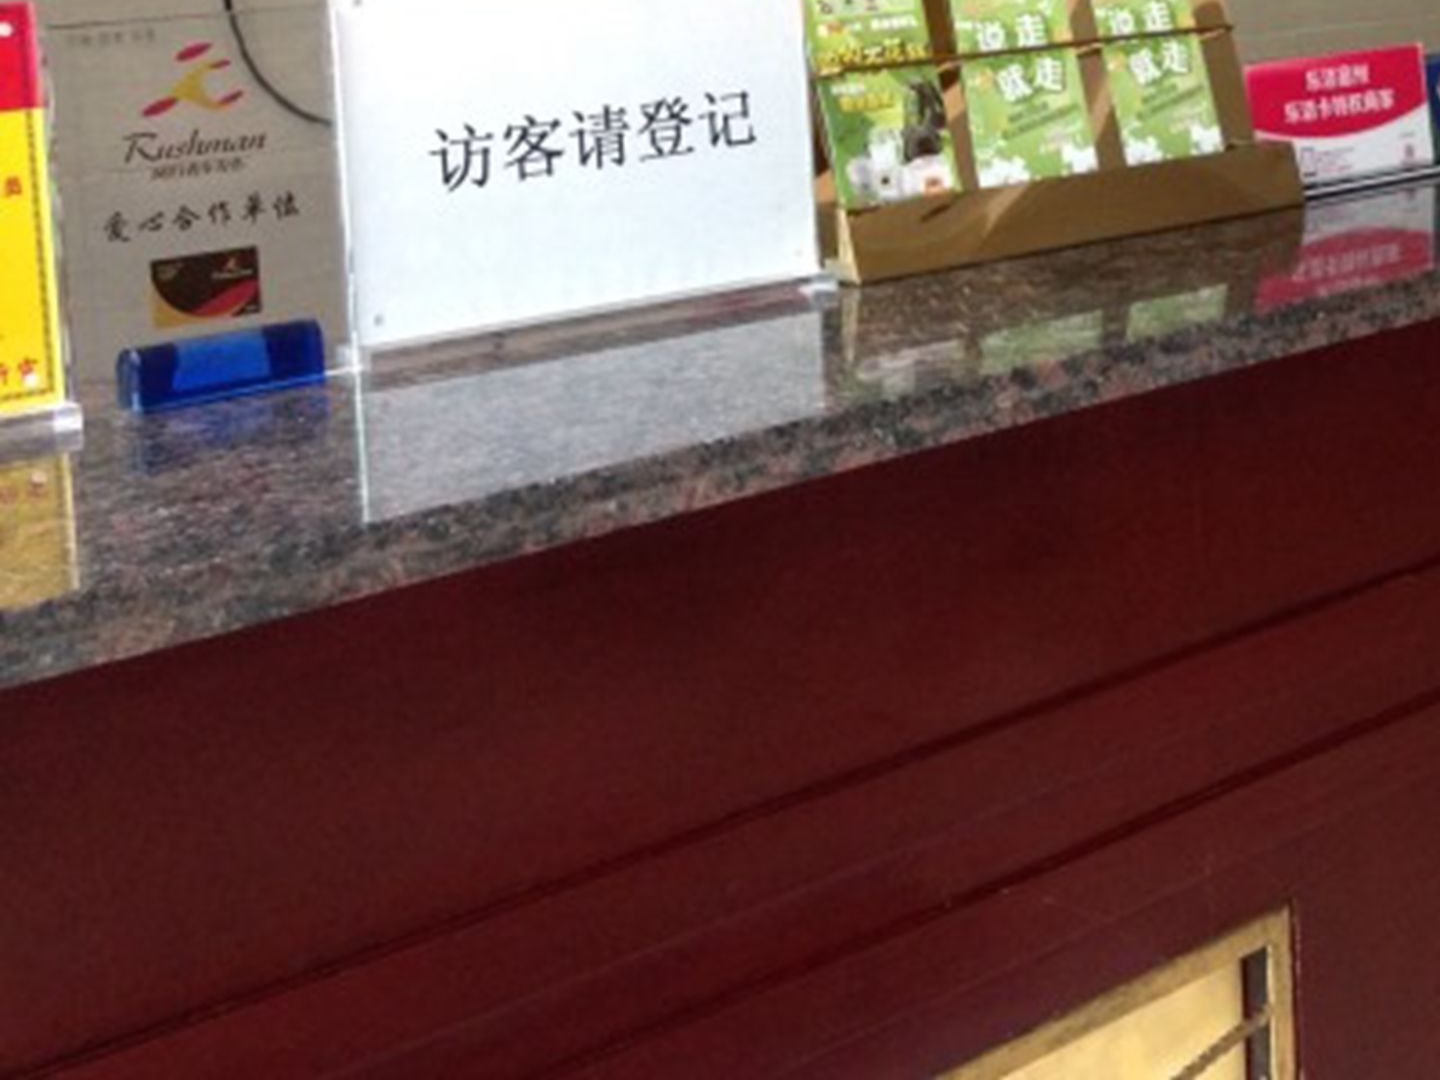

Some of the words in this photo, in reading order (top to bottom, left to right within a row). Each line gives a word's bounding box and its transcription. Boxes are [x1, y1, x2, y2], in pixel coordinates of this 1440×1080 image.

[122, 128, 267, 163] Rushman
[429, 91, 757, 192] 访客请登记
[104, 190, 300, 242] 爱心合作单位
